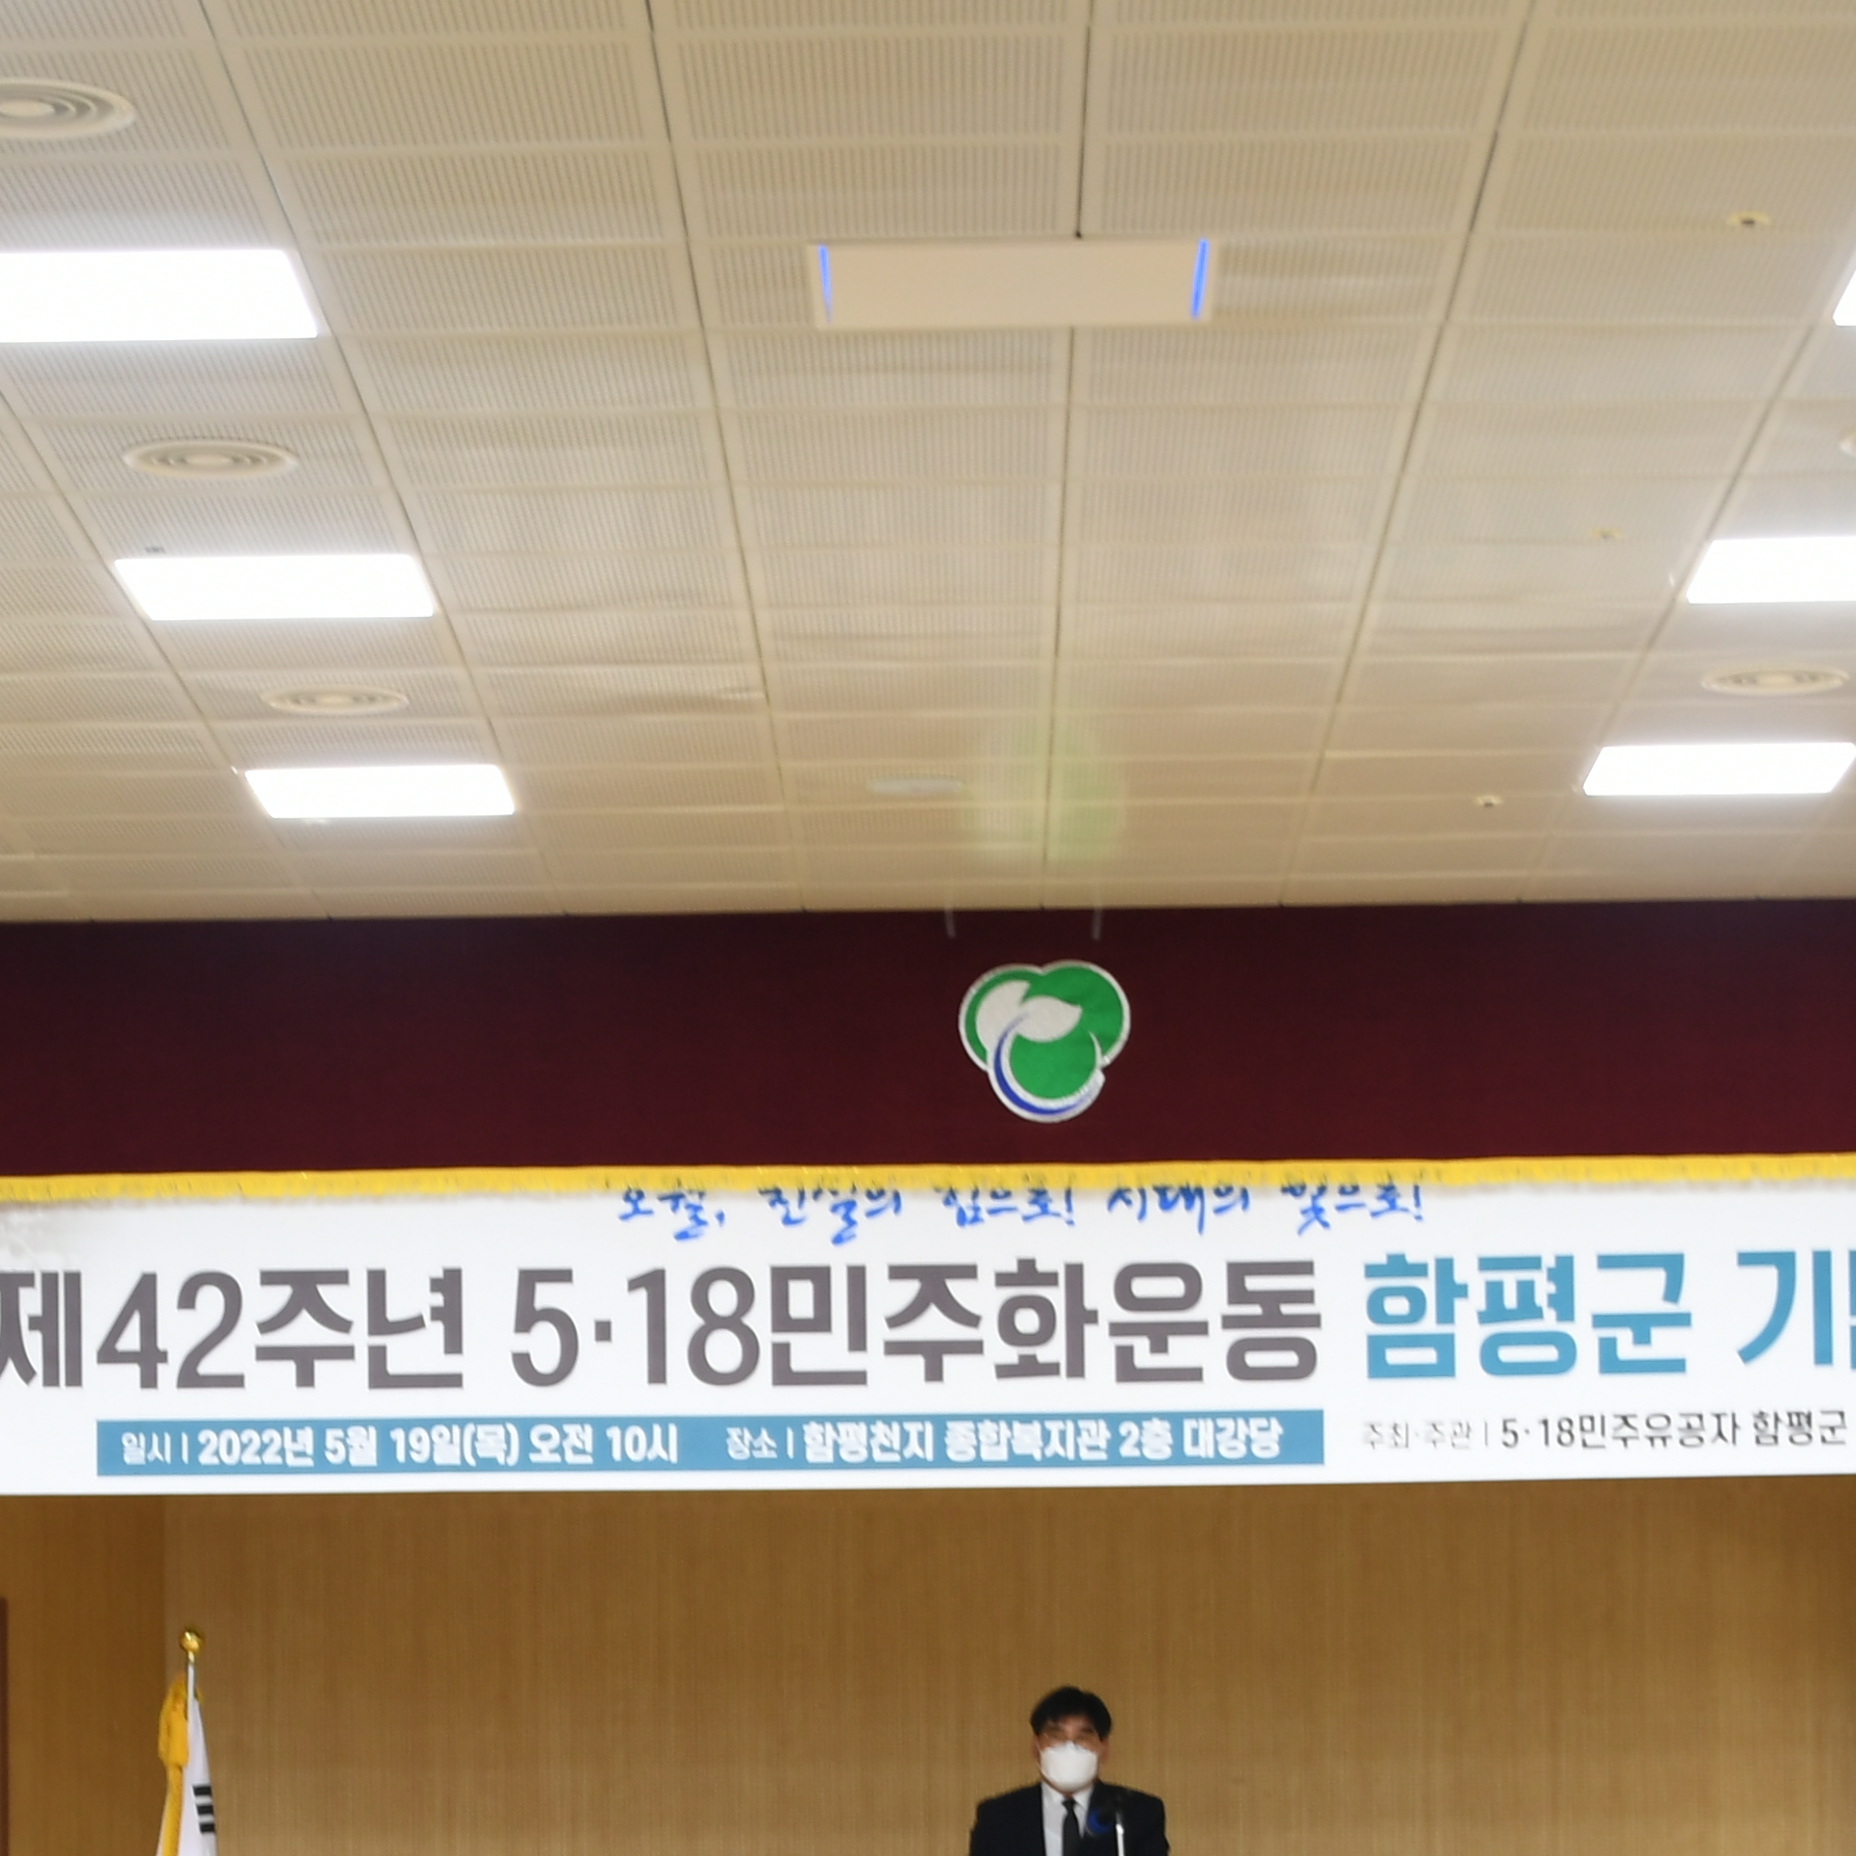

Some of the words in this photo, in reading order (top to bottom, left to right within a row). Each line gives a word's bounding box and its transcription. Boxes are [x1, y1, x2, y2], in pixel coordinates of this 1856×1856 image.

[510, 1256, 1323, 1387] 5·18민주화운동
[1363, 1252, 1693, 1380] 함평군
[121, 1431, 172, 1466] 일시
[197, 1427, 314, 1468] 2022년
[324, 1426, 378, 1467] 5월
[389, 1424, 520, 1467] 19일(목)
[528, 1422, 594, 1465] 오전
[605, 1422, 679, 1464] 10시
[725, 1426, 778, 1461] 장소
[802, 1419, 934, 1464] 함평천지
[943, 1418, 1111, 1463] 종합복지관
[1118, 1419, 1174, 1461] 2층
[1182, 1416, 1284, 1460] 대강당
[1751, 1408, 1848, 1447] 함평군
